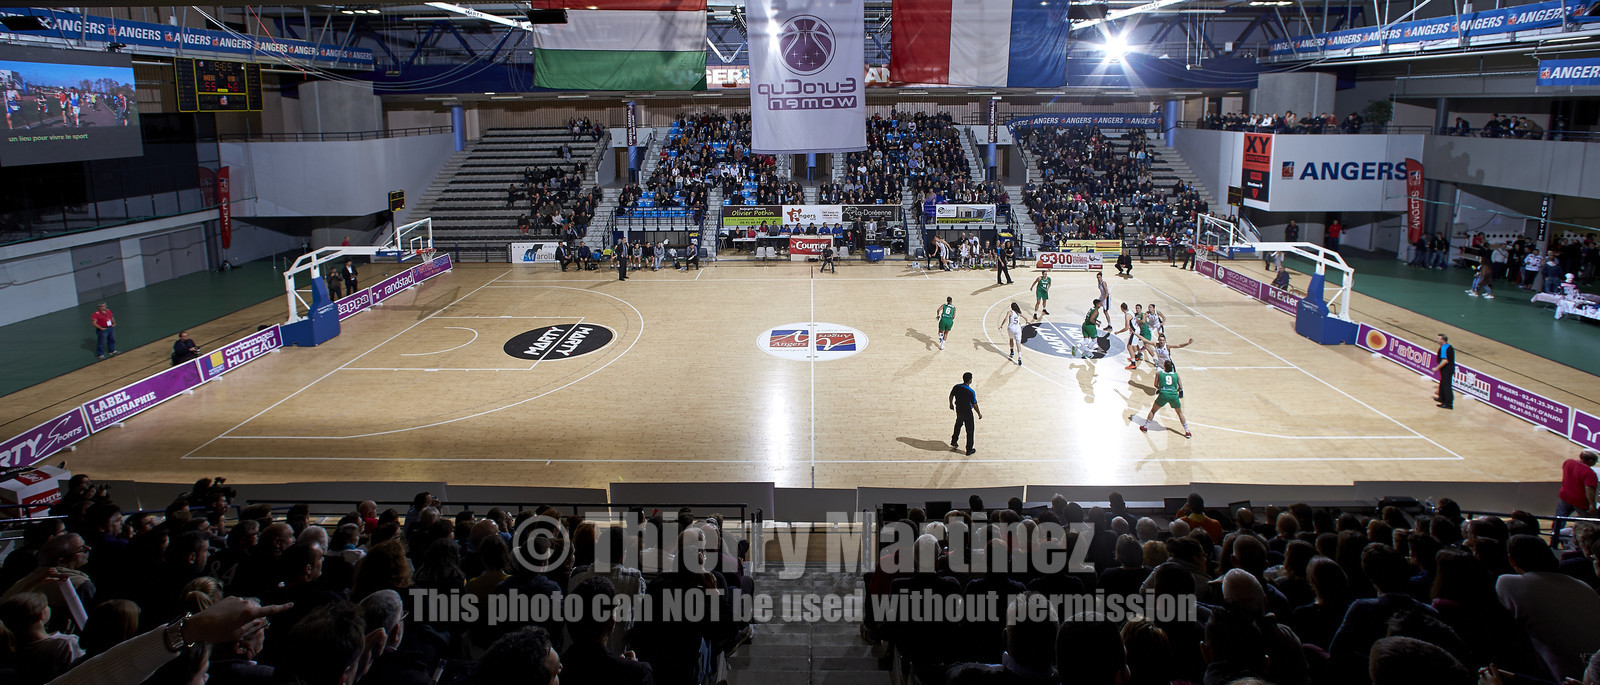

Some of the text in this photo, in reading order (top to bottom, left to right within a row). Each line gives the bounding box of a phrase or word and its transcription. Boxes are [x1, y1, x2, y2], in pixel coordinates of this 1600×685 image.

[1515, 6, 1572, 25] ANGERS
[53, 19, 105, 35] ANGERS
[1411, 23, 1450, 37] ANGERS
[1460, 16, 1504, 31] ANGERS
[118, 26, 161, 41] ANGERS
[174, 32, 211, 46] ANGERS
[1332, 34, 1362, 46] ANGERS
[1368, 29, 1401, 41] ANGERS
[220, 37, 252, 50] ANGERS
[260, 42, 288, 53] ANGERS
[1300, 38, 1326, 48] ANGERS
[294, 45, 320, 56] ANGERS
[1550, 65, 1600, 79] ANGER
[1033, 117, 1059, 125] ANGERS
[1130, 117, 1156, 125] ANGERS
[72, 133, 89, 141] sport
[1246, 136, 1271, 154] XY
[1299, 161, 1408, 181] ANGERS
[796, 240, 829, 251] Courrier
[1050, 253, 1073, 265] 300
[384, 273, 412, 295] randstad
[1269, 287, 1276, 299] In
[945, 306, 951, 315] 6
[225, 330, 275, 357] cartonnages
[524, 326, 565, 355] MARTY
[556, 326, 593, 356] MARTY
[227, 338, 277, 368] HUTEAU
[1389, 337, 1432, 369] l'atoll
[1165, 375, 1173, 386] 9
[90, 391, 130, 415] LABEL
[1497, 384, 1519, 397] ANGERS
[1521, 393, 1563, 414] 02.41.25.39.25
[93, 391, 157, 425] SÉRIGRAPHIE
[1509, 403, 1548, 424] 02.41.05.10.10
